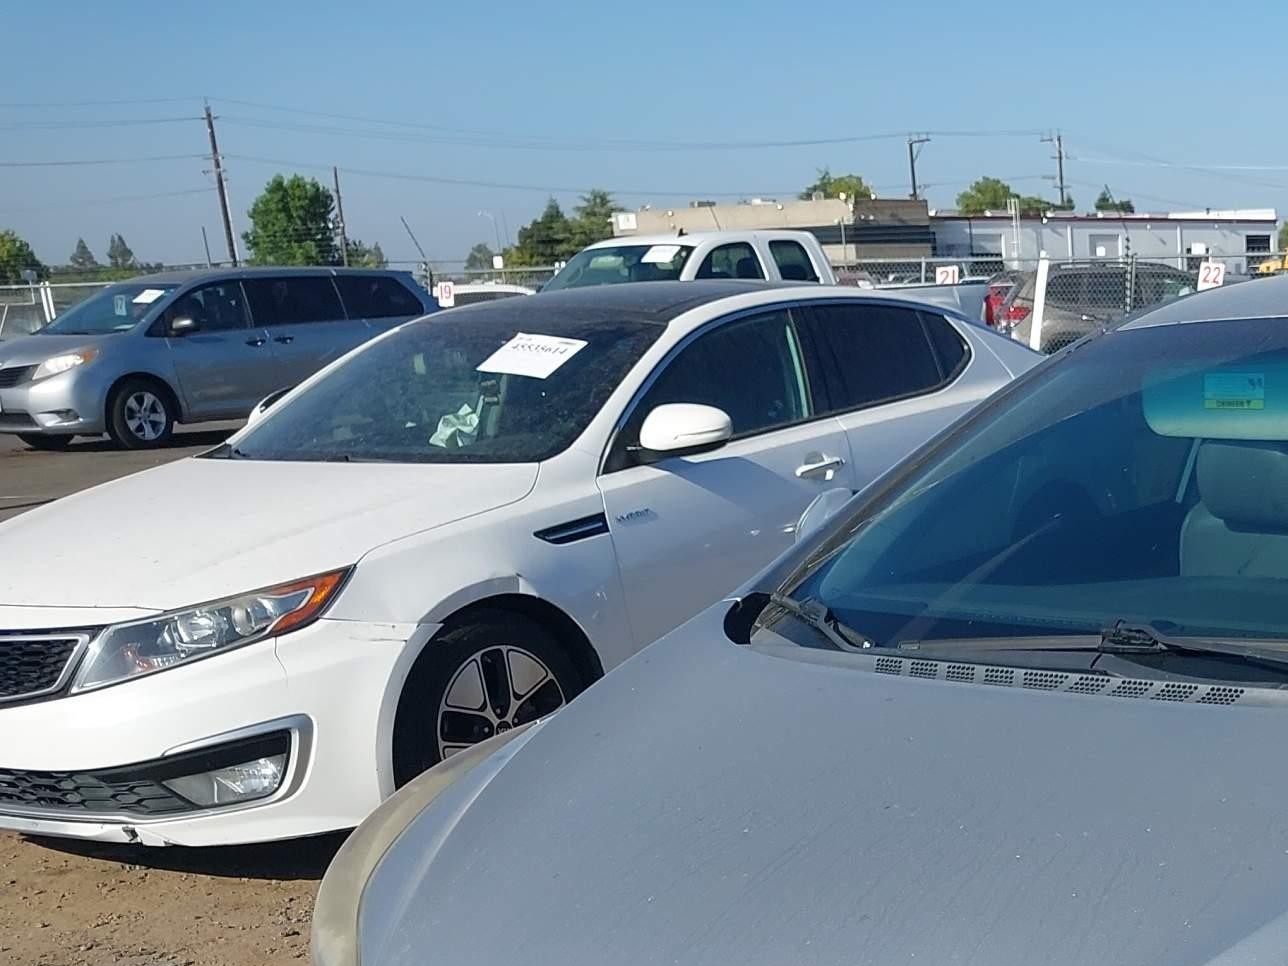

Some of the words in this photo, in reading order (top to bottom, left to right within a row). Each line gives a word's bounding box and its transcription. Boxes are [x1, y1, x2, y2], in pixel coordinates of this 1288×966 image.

[939, 269, 956, 285] 21
[1202, 265, 1221, 285] 22
[439, 284, 452, 300] 19
